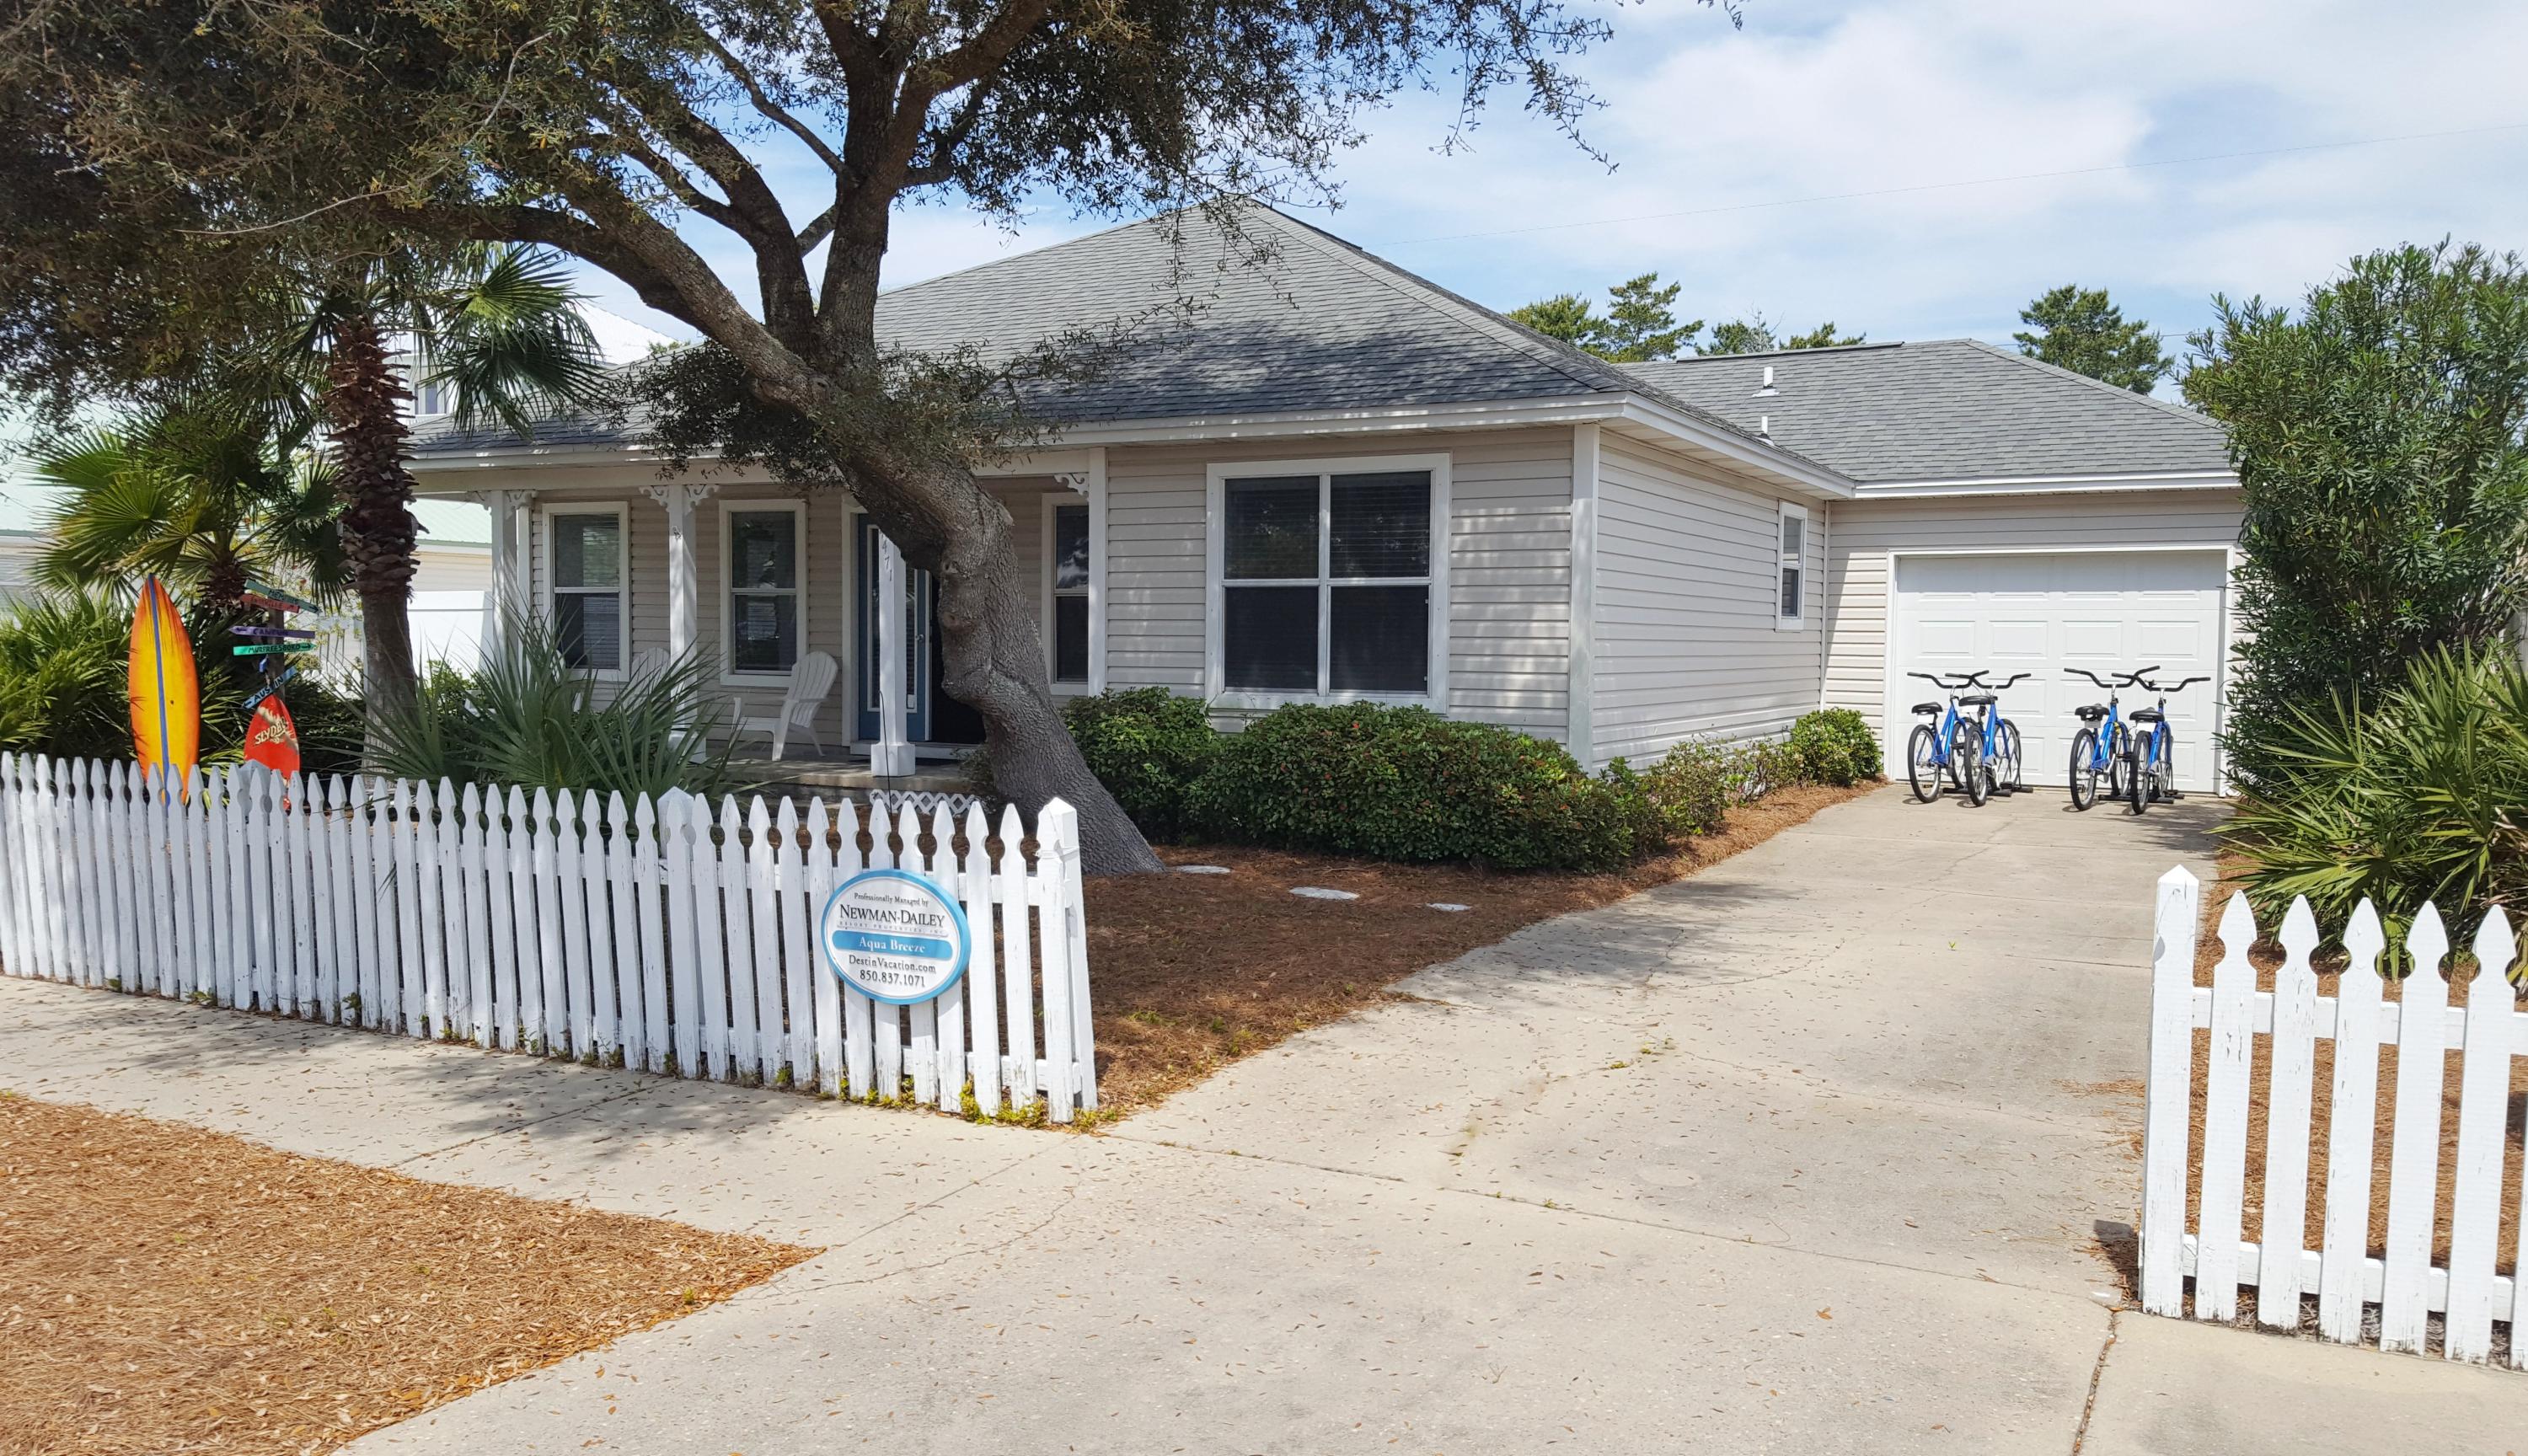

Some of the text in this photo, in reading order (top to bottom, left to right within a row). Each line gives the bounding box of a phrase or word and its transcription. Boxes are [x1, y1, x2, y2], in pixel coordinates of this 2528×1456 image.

[854, 892, 929, 907] Professionally Managed by
[860, 936, 926, 953] Aqua Breeze
[849, 955, 936, 974] DestinVacation.com
[860, 970, 925, 988] 850.837.1071
